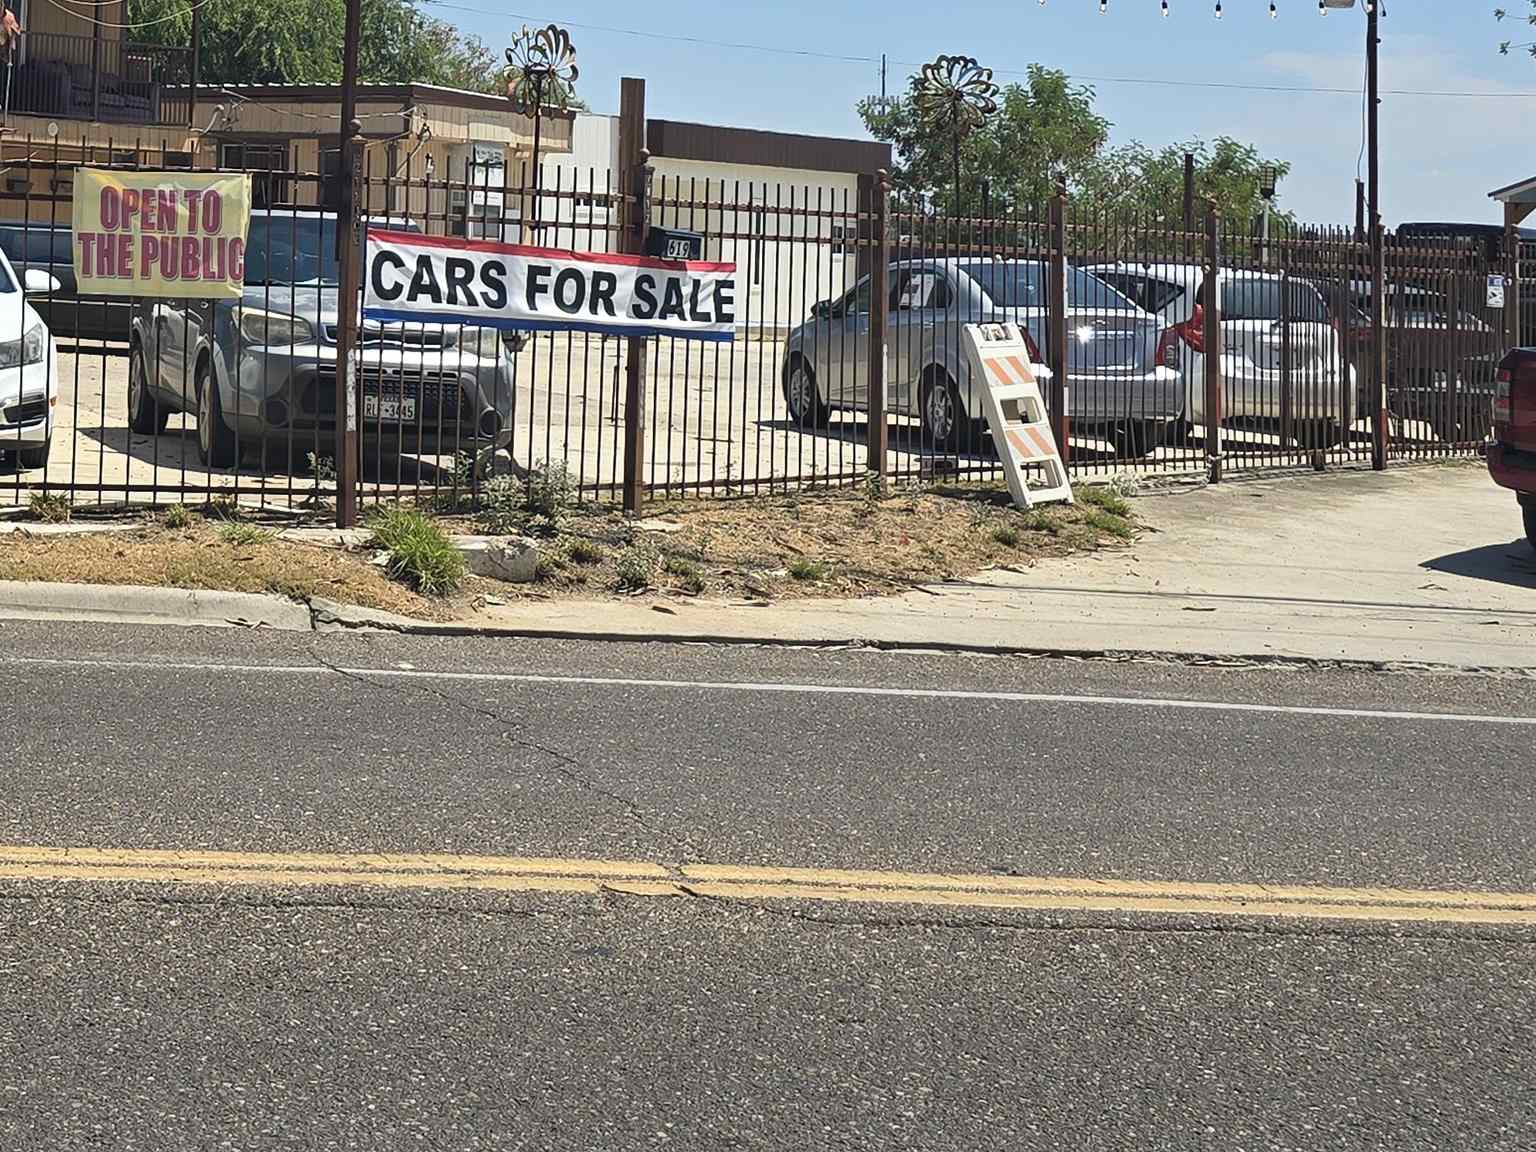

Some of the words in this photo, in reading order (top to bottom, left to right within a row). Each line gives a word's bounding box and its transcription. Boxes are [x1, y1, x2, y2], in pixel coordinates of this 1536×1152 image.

[100, 185, 177, 234] OPEN
[184, 189, 222, 235] TO
[78, 233, 134, 279] THE
[140, 235, 244, 284] PUBLIC
[668, 240, 690, 257] 619
[371, 250, 508, 310] CARS
[526, 264, 616, 317] FOR
[630, 275, 735, 323] SALE
